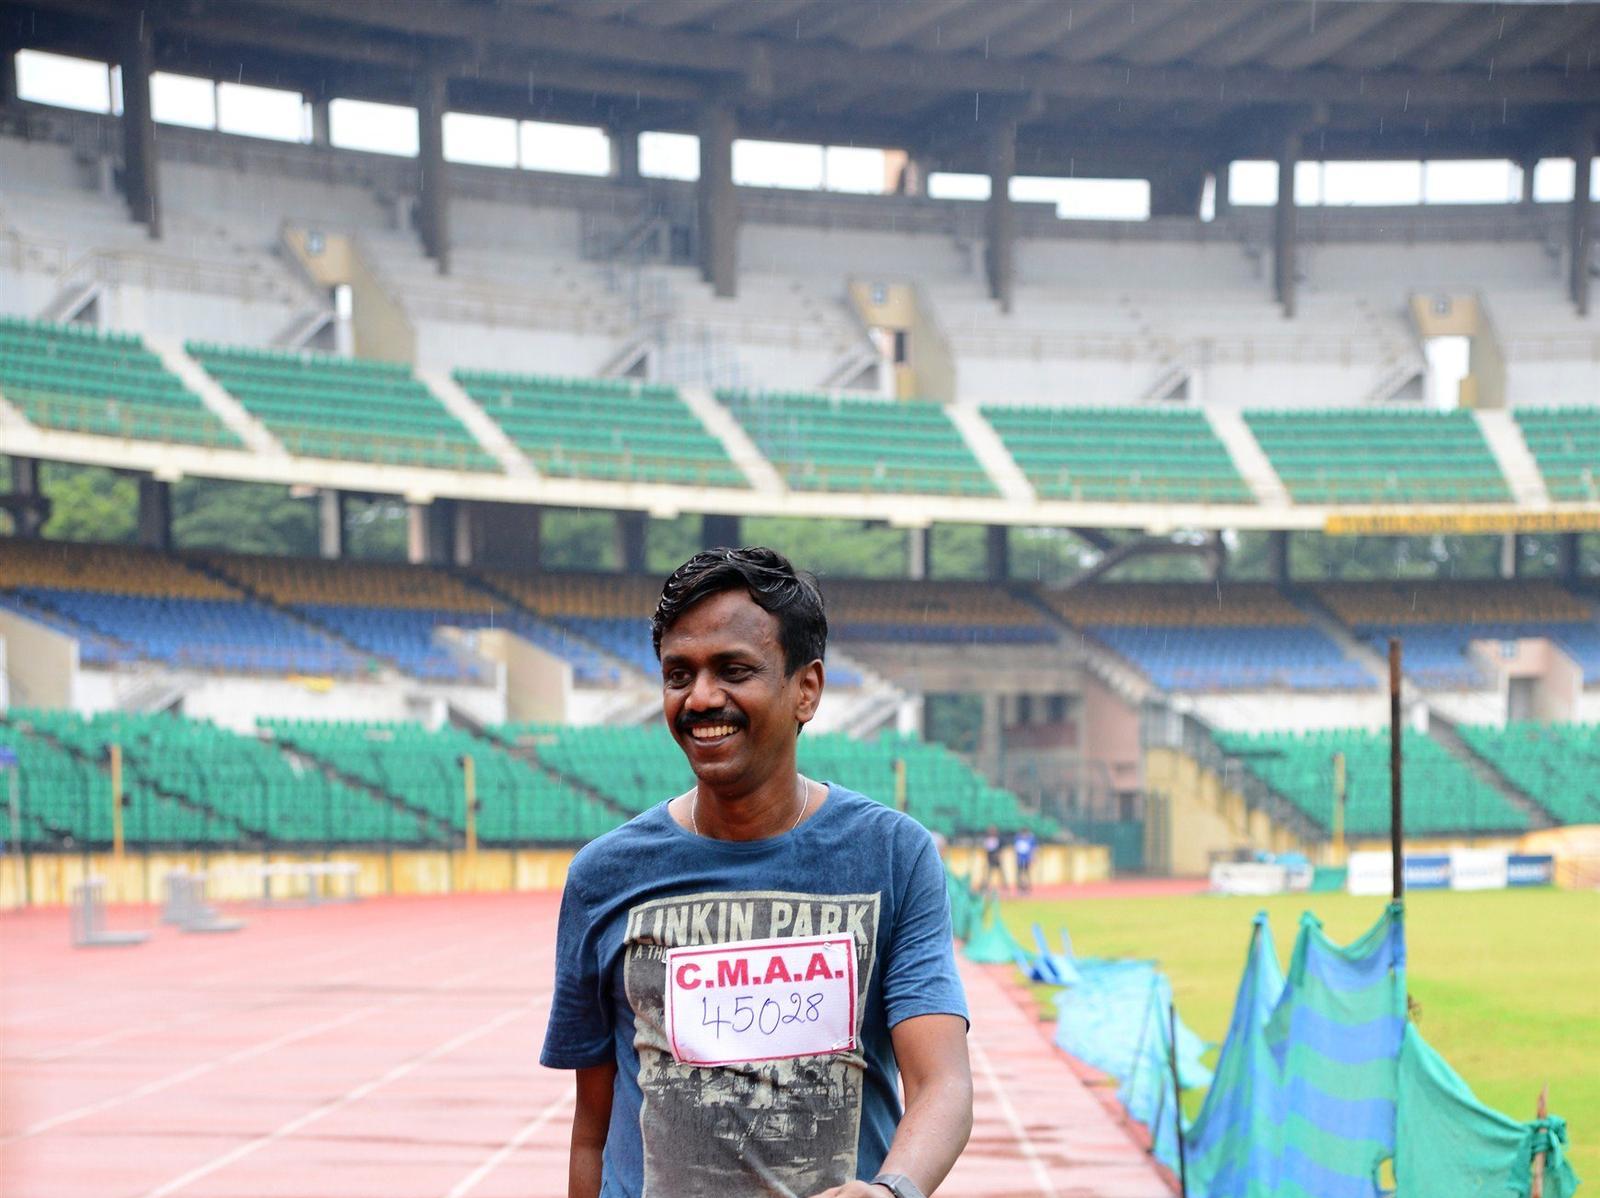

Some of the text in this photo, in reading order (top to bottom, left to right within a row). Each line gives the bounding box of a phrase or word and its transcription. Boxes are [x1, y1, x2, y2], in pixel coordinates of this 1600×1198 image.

[632, 901, 870, 946] LINKIN PARK
[635, 944, 643, 960] A
[676, 952, 844, 990] C.M.A.A.
[701, 992, 824, 1039] 45028
